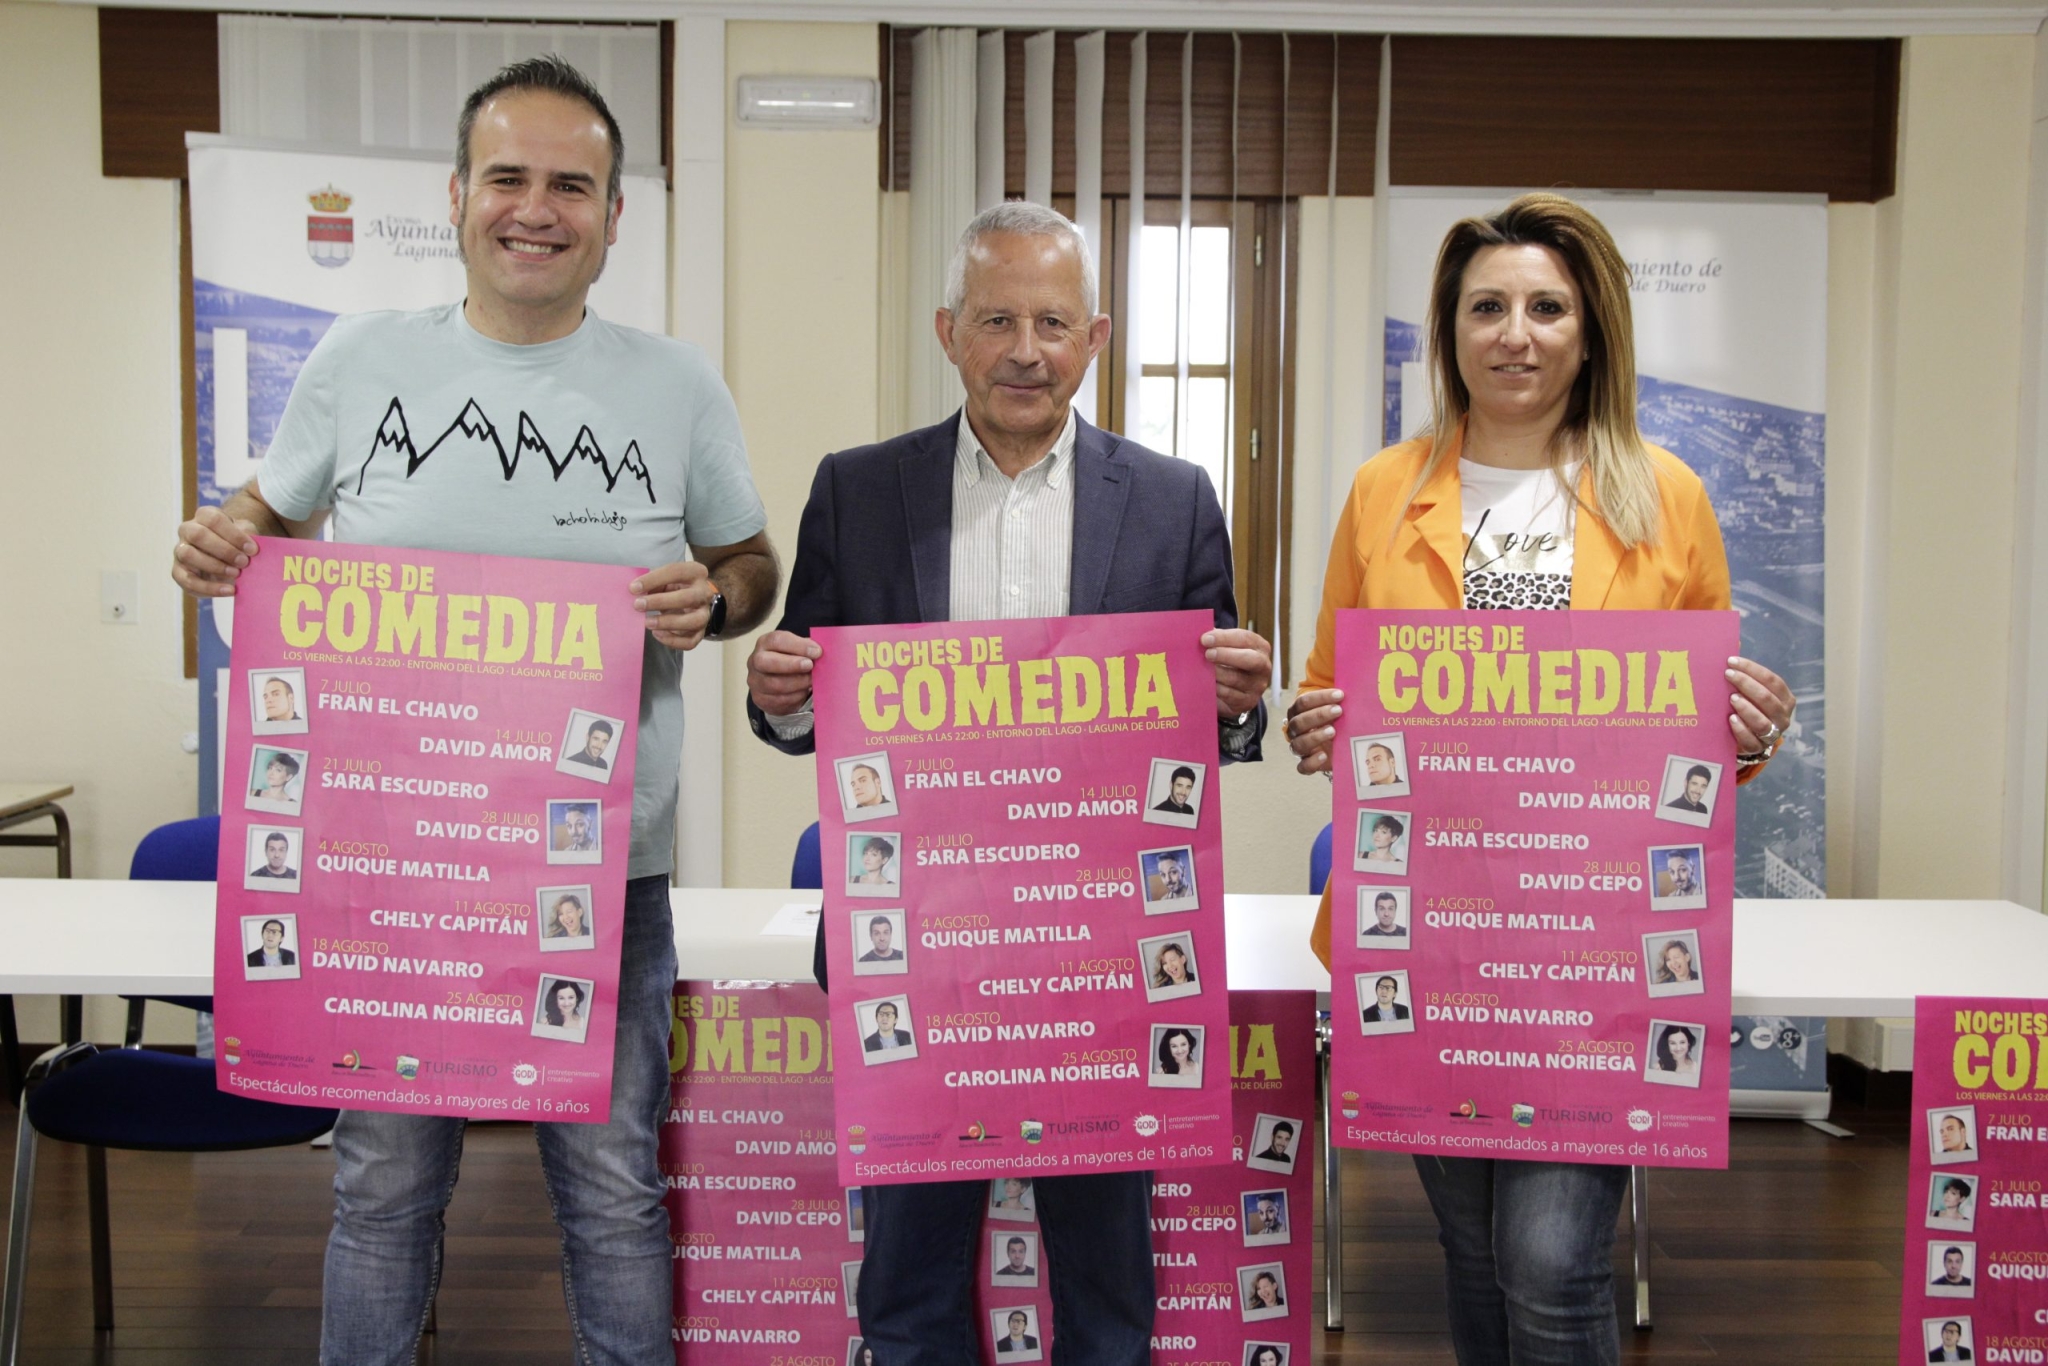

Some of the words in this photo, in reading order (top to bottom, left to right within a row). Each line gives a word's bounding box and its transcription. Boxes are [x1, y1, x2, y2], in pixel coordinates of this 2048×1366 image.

[1656, 279, 1706, 293] Duero
[1462, 508, 1558, 572] Love
[283, 556, 392, 590] NOCHES
[400, 565, 434, 592] DE
[280, 583, 603, 670] COMEDIA
[1378, 624, 1482, 651] NOCHES
[1492, 625, 1524, 650] DE
[856, 638, 962, 667] NOCHES
[971, 636, 1004, 662] DE
[321, 678, 329, 691] 7
[331, 679, 371, 695] JULIO
[1378, 648, 1698, 716] COMEDIA
[857, 652, 1179, 732] COMEDIA
[318, 692, 373, 713] FRAN
[377, 697, 401, 715] EL
[405, 700, 478, 721] CHAVO
[495, 728, 510, 742] 14
[513, 729, 552, 745] JULIO
[865, 735, 884, 746] LOS
[885, 733, 924, 744] VIERNES
[926, 733, 934, 742] A
[935, 732, 953, 742] LAS
[955, 730, 980, 741] 22:00
[986, 727, 1033, 739] ENTORNO
[1034, 726, 1053, 736] DEL
[1054, 724, 1082, 736] LAGO
[1088, 722, 1129, 734] LAGUNA
[1130, 721, 1144, 731] DE
[1145, 719, 1180, 730] DUERO
[419, 736, 486, 757] DAVID
[489, 742, 552, 762] AMOR
[1420, 741, 1427, 754] 7
[1430, 741, 1469, 755] JULIO
[323, 756, 338, 770] 21
[342, 758, 382, 774] JULIO
[1418, 755, 1471, 772] FRAN
[1476, 756, 1499, 772] EL
[1502, 756, 1575, 774] CHAVO
[321, 771, 375, 791] SARA
[380, 776, 489, 800] ESCUDERO
[904, 771, 958, 789] FRAN
[962, 770, 986, 787] EL
[989, 766, 1062, 786] CHAVO
[1593, 779, 1608, 791] 14
[1611, 779, 1650, 793] JULIO
[1007, 801, 1072, 820] DAVID
[1076, 798, 1138, 817] AMOR
[1518, 791, 1584, 809] DAVID
[1588, 793, 1650, 810] AMOR
[480, 810, 497, 824] 28
[500, 812, 539, 827] JULIO
[1426, 816, 1440, 829] 21
[1444, 817, 1483, 831] JULIO
[415, 819, 482, 840] DAVID
[485, 825, 540, 844] CEPO
[1425, 830, 1478, 848] SARA
[1482, 832, 1589, 850] ESCUDERO
[317, 840, 327, 852] 4
[330, 840, 389, 857] AGOSTO
[916, 848, 970, 866] SARA
[974, 842, 1080, 863] ESCUDERO
[316, 853, 397, 876] QUIQUE
[401, 860, 490, 882] MATILLA
[1583, 860, 1599, 873] 28
[1602, 861, 1641, 874] JULIO
[1013, 883, 1078, 902] DAVID
[1082, 880, 1135, 899] CEPO
[1519, 873, 1585, 890] DAVID
[1588, 874, 1643, 892] CEPO
[454, 899, 468, 912] 11
[472, 900, 531, 917] AGOSTO
[1425, 896, 1434, 909] 4
[1437, 896, 1494, 911] AGOSTO
[369, 909, 435, 929] CHELY
[438, 914, 528, 935] CAPITÁN
[1424, 910, 1503, 930] QUIQUE
[1507, 913, 1595, 931] MATILLA
[312, 937, 328, 950] 18
[330, 938, 389, 955] AGOSTO
[920, 928, 1000, 949] QUIQUE
[1004, 924, 1091, 944] MATILLA
[312, 950, 379, 971] DAVID
[382, 956, 484, 978] NAVARRO
[1561, 949, 1574, 962] 11
[1579, 950, 1638, 965] AGOSTO
[1478, 961, 1543, 979] CHELY
[1546, 962, 1635, 982] CAPITÁN
[978, 977, 1042, 996] CHELY
[1046, 969, 1134, 993] CAPITÁN
[446, 991, 462, 1004] 25
[465, 992, 523, 1008] AGOSTO
[1424, 992, 1439, 1004] 18
[1442, 992, 1499, 1007] AGOSTO
[324, 996, 428, 1020] CAROLINA
[432, 1004, 524, 1025] NORIEGA
[1425, 1004, 1490, 1023] DAVID
[1494, 1007, 1594, 1026] NAVARRO
[927, 1025, 992, 1044] DAVID
[996, 1020, 1095, 1041] NAVARRO
[1955, 1010, 2048, 1036] NOCHES
[1557, 1039, 1573, 1052] 25
[1577, 1039, 1634, 1054] AGOSTO
[424, 1060, 498, 1077] TURISMO
[1439, 1048, 1541, 1068] CAROLINA
[1545, 1053, 1636, 1071] NORIEGA
[944, 1067, 1046, 1088] CAROLINA
[1050, 1062, 1140, 1082] NORIEGA
[229, 1071, 318, 1097] Espectáculos
[321, 1086, 430, 1105] recomendados
[434, 1094, 442, 1106] a
[446, 1095, 508, 1110] mayores
[511, 1095, 531, 1111] de
[535, 1097, 552, 1112] 16
[554, 1099, 590, 1114] años
[1254, 1082, 1282, 1090] DUERO
[722, 1110, 784, 1124] CHAVO
[1047, 1120, 1120, 1134] TURISMO
[1986, 1126, 2033, 1140] FRAN
[736, 1140, 792, 1154] DAVID
[1347, 1125, 1437, 1146] Espectáculos
[1440, 1135, 1548, 1151] recomendados
[1550, 1141, 1559, 1152] a
[1563, 1141, 1625, 1156] mayores
[1628, 1141, 1647, 1156] de
[1652, 1142, 1669, 1157] 16
[1672, 1144, 1708, 1158] años
[855, 1157, 947, 1178] Espectáculos
[950, 1152, 1058, 1171] recomendados
[1061, 1154, 1070, 1166] a
[1073, 1150, 1134, 1167] mayores
[1136, 1146, 1155, 1161] de
[1160, 1145, 1177, 1159] 16
[1179, 1144, 1213, 1158] años
[704, 1176, 796, 1190] ESCUDERO
[1990, 1192, 2036, 1208] SARA
[796, 1212, 842, 1226] CEPO
[1192, 1218, 1237, 1231] CEPO
[726, 1246, 802, 1260] MATILLA
[702, 1289, 758, 1304] CHELY
[760, 1288, 836, 1304] CAPITÁN
[1156, 1293, 1232, 1310] CAPITÁN
[716, 1329, 800, 1344] NAVARRO
[1986, 1347, 2044, 1363] DAVID
